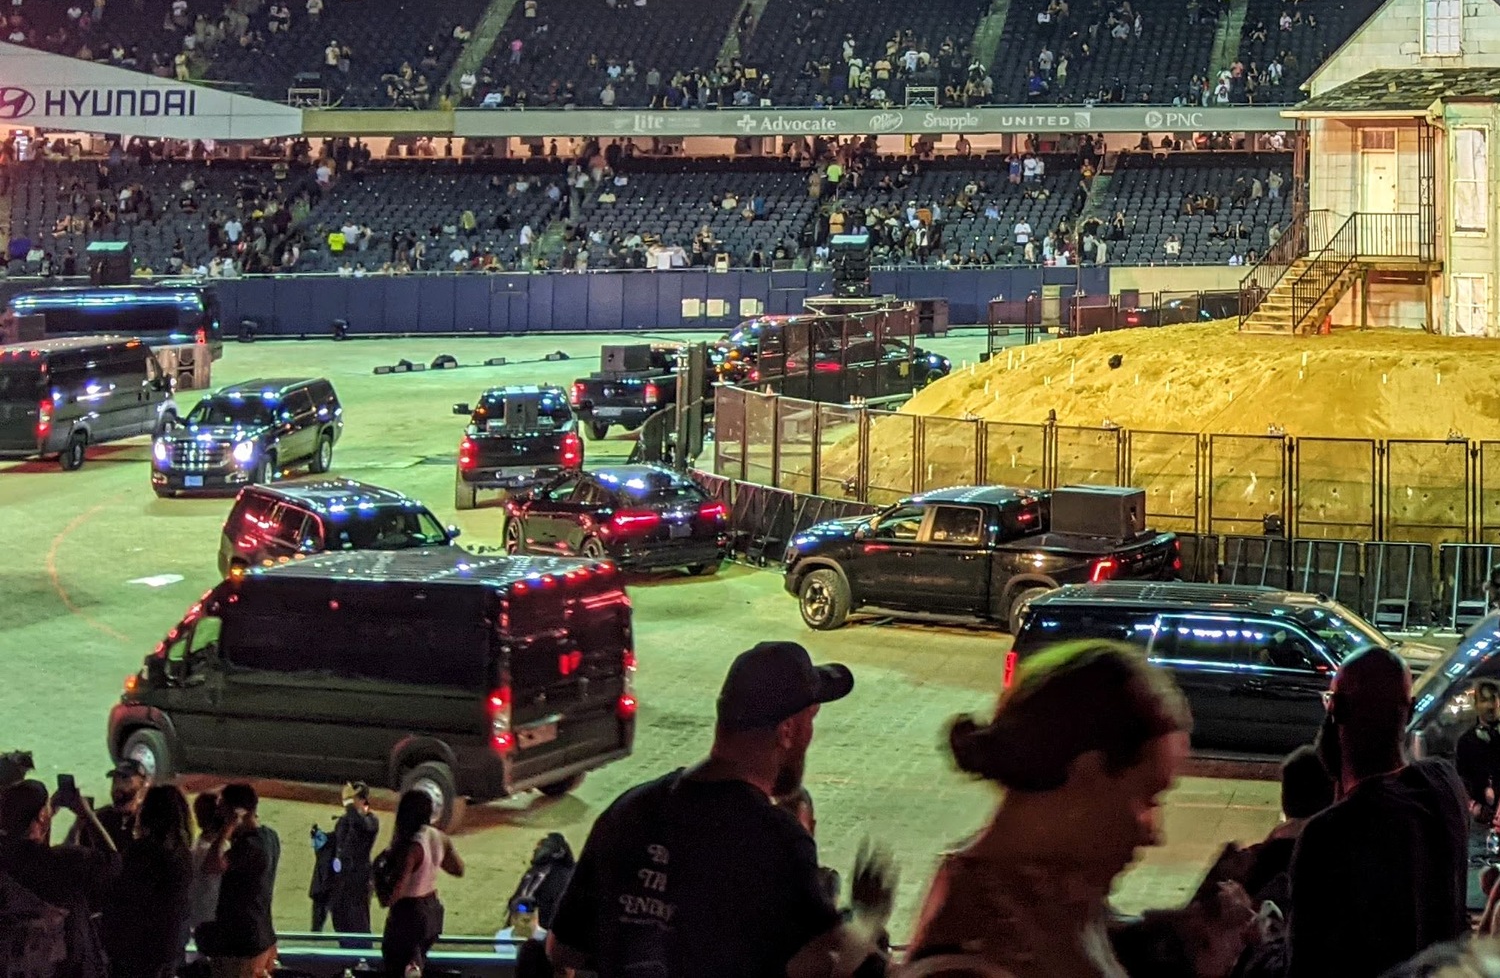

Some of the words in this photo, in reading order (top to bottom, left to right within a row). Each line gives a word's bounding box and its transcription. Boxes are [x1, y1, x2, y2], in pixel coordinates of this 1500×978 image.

[45, 89, 195, 116] HYUNDAI
[633, 114, 665, 132] Lite
[760, 116, 836, 131] Advocate
[923, 113, 979, 130] Snapple
[1002, 116, 1070, 126] UNITED
[1166, 113, 1203, 127] PNC
